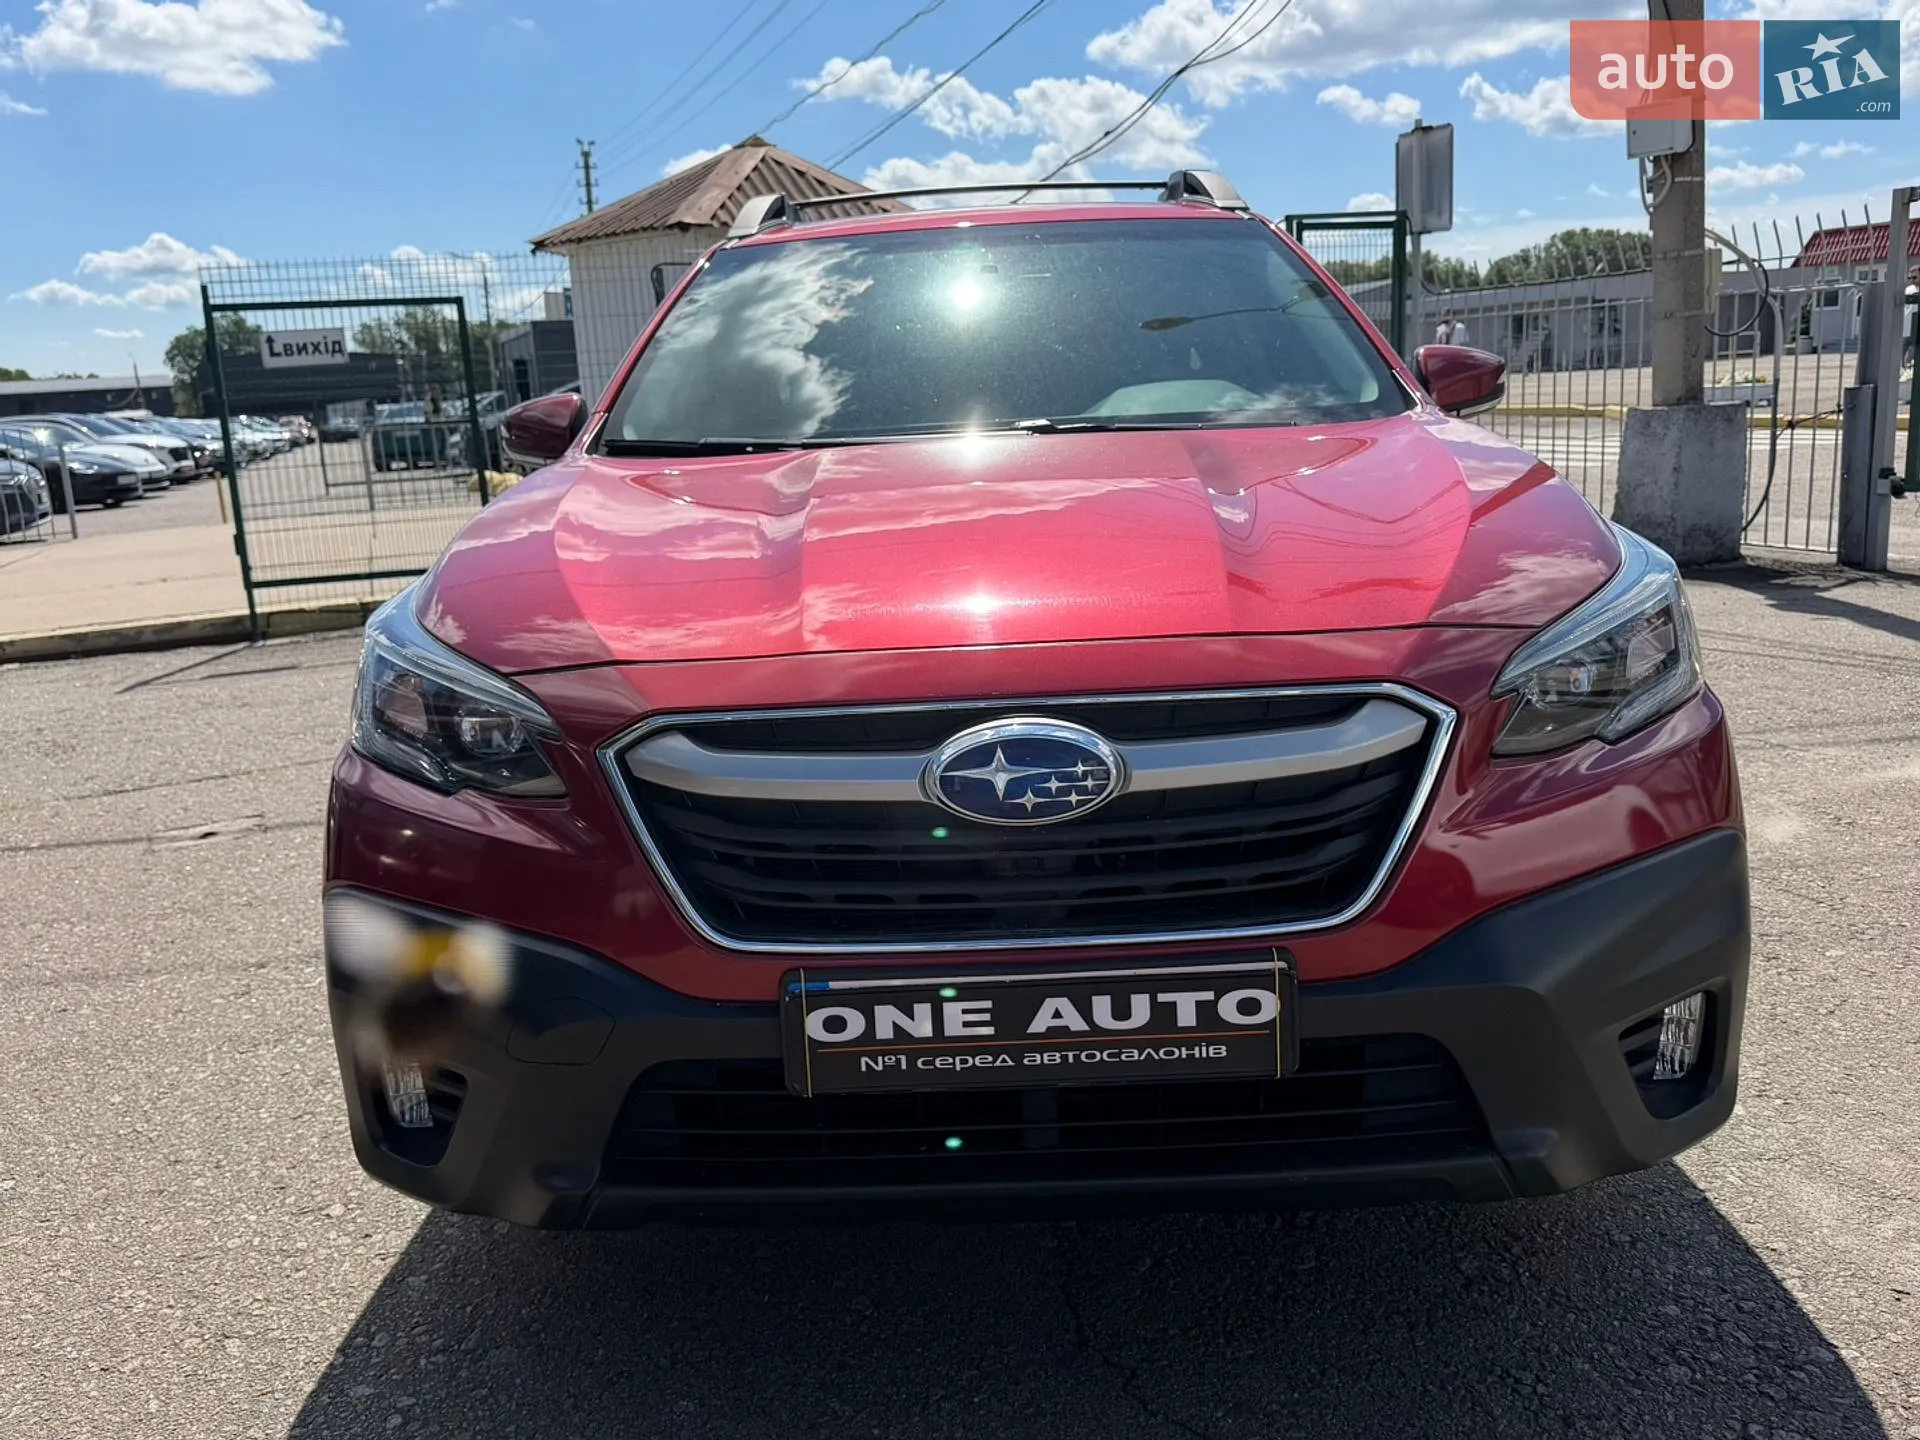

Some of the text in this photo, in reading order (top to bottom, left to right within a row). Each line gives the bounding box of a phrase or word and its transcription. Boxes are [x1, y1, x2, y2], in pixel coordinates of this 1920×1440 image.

[805, 989, 1280, 1043] ONE AUTO
[917, 1052, 1015, 1070] серед
[1023, 1043, 1228, 1066] автосалонів
